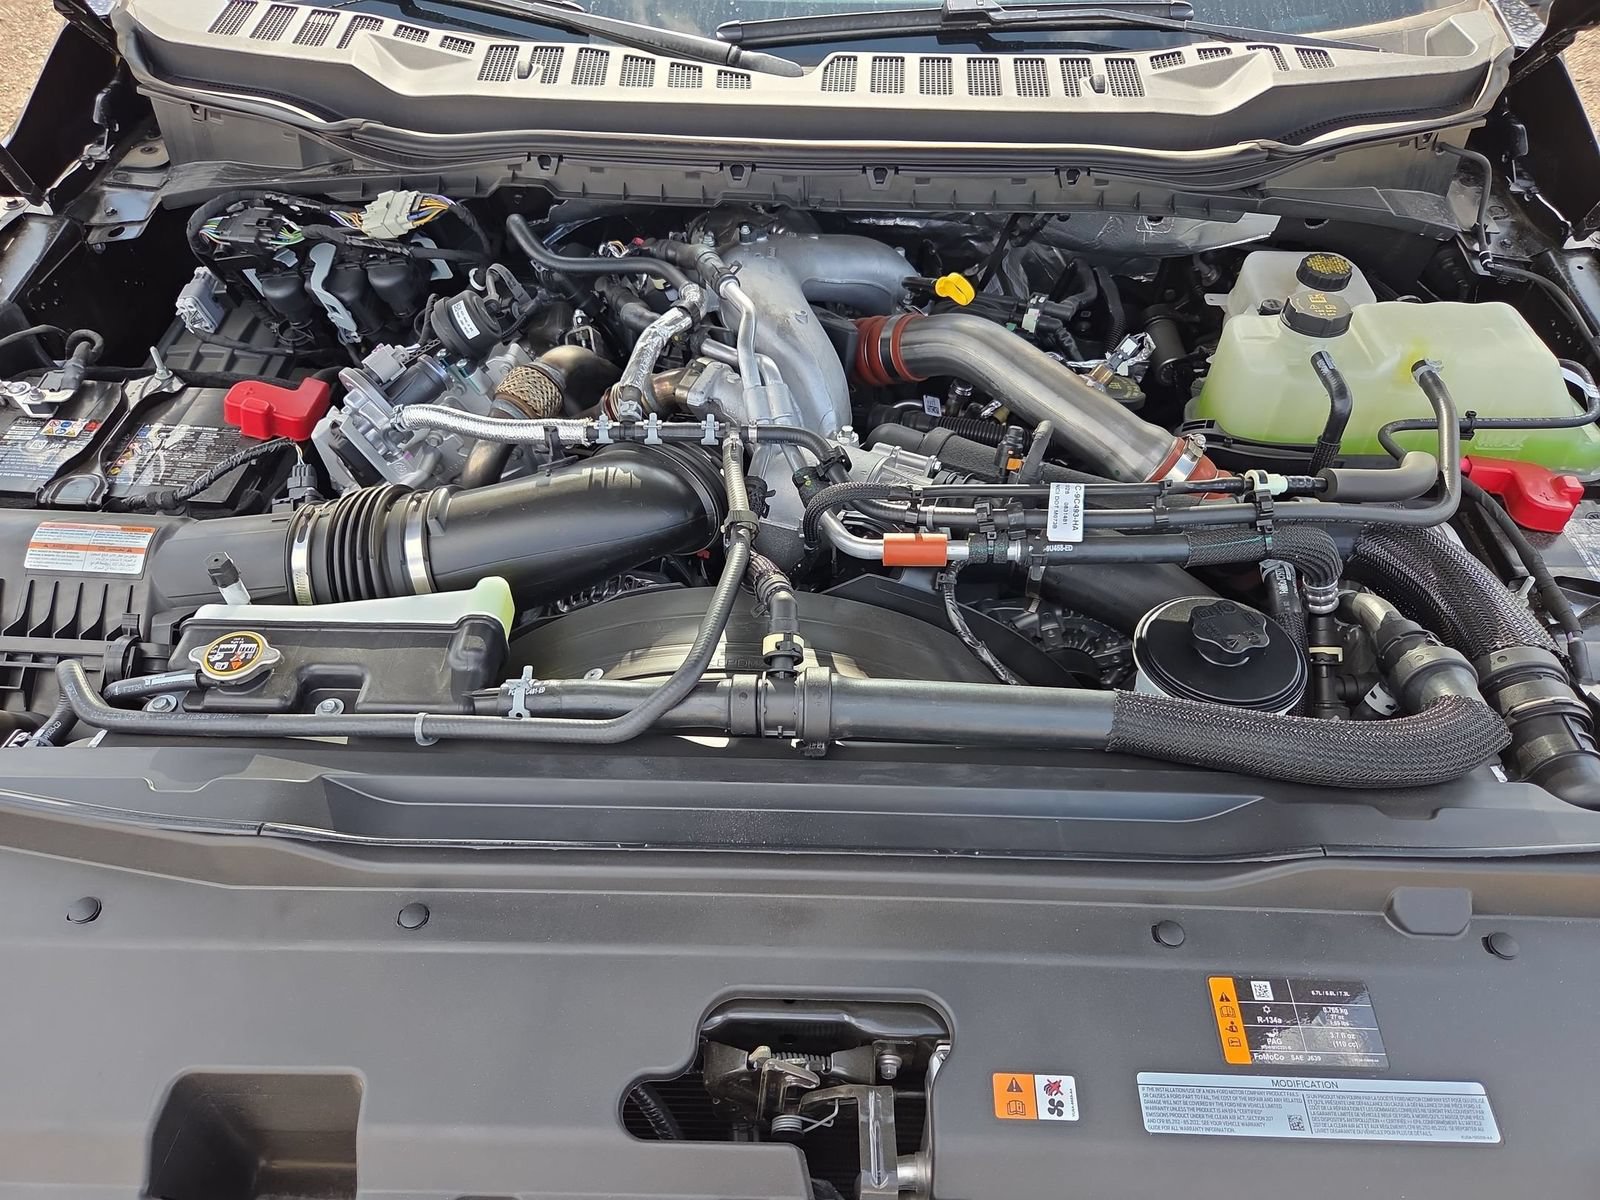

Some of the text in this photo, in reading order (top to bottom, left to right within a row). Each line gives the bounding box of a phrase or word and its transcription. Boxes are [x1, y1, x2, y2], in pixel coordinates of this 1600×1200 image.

[1257, 1016, 1282, 1024] R-134a
[1253, 1053, 1285, 1061] FoMoCo
[1271, 1079, 1339, 1089] MODIFICATION
